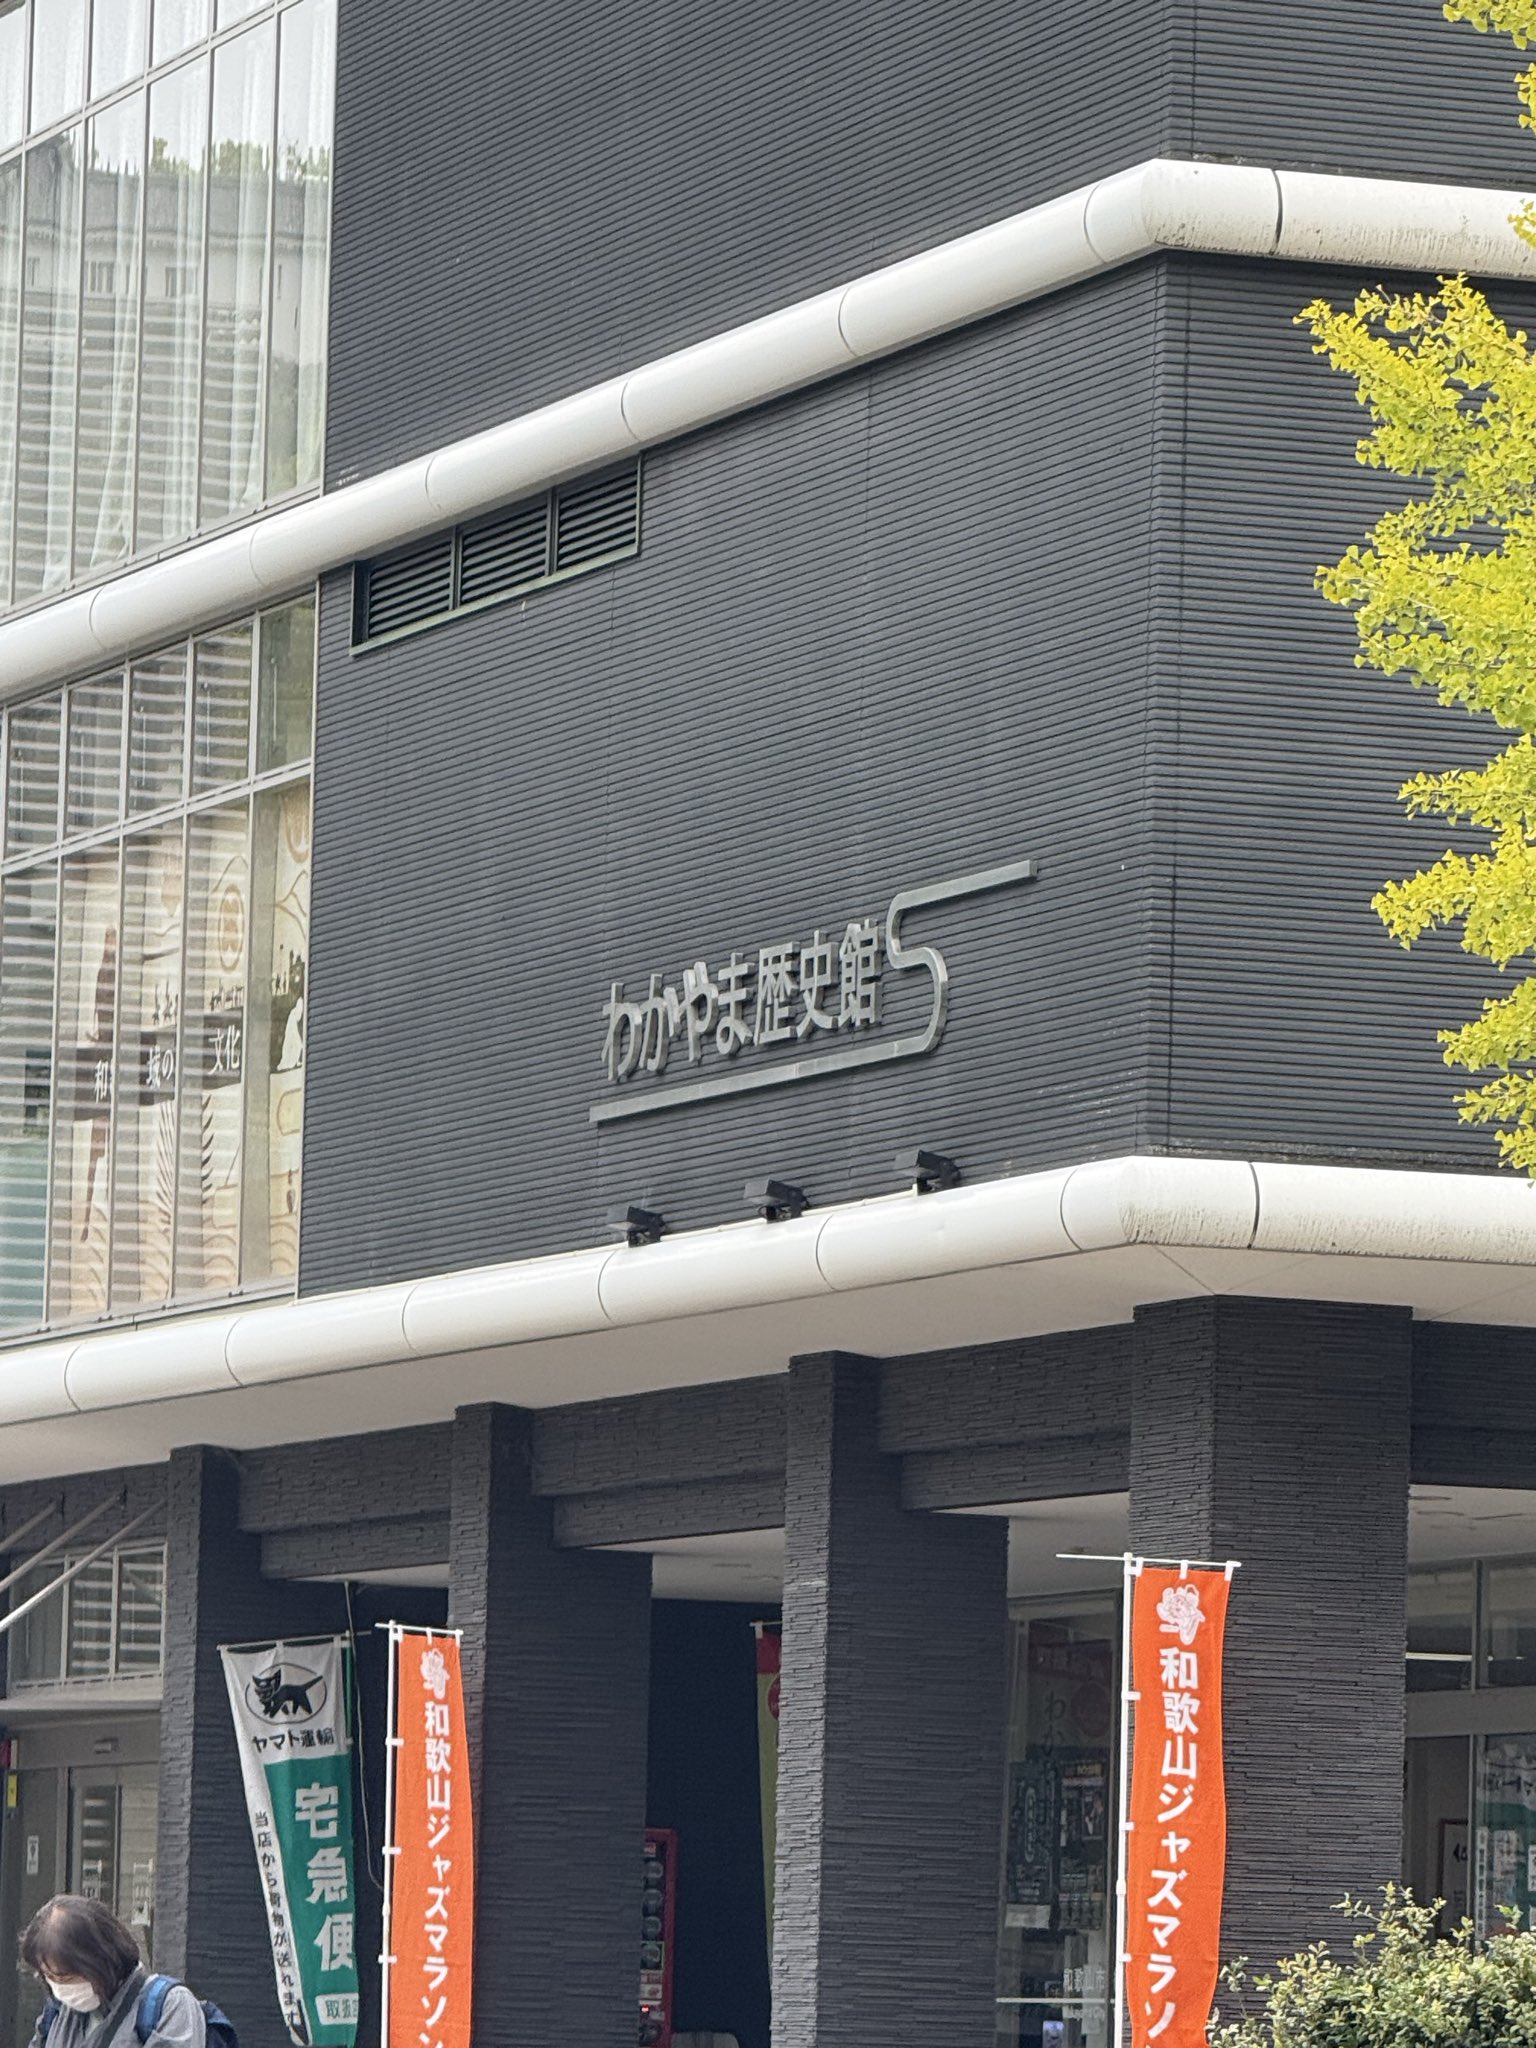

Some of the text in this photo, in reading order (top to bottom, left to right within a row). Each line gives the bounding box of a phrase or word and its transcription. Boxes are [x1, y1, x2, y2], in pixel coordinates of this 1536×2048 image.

[208, 1024, 241, 1075] 文化
[602, 918, 885, 1082] わかやま歴史館
[252, 1727, 335, 1753] ヤマト運輸
[295, 1782, 354, 1972] 宅急便
[1144, 1646, 1199, 2048] 和歌山ジャズマラソ
